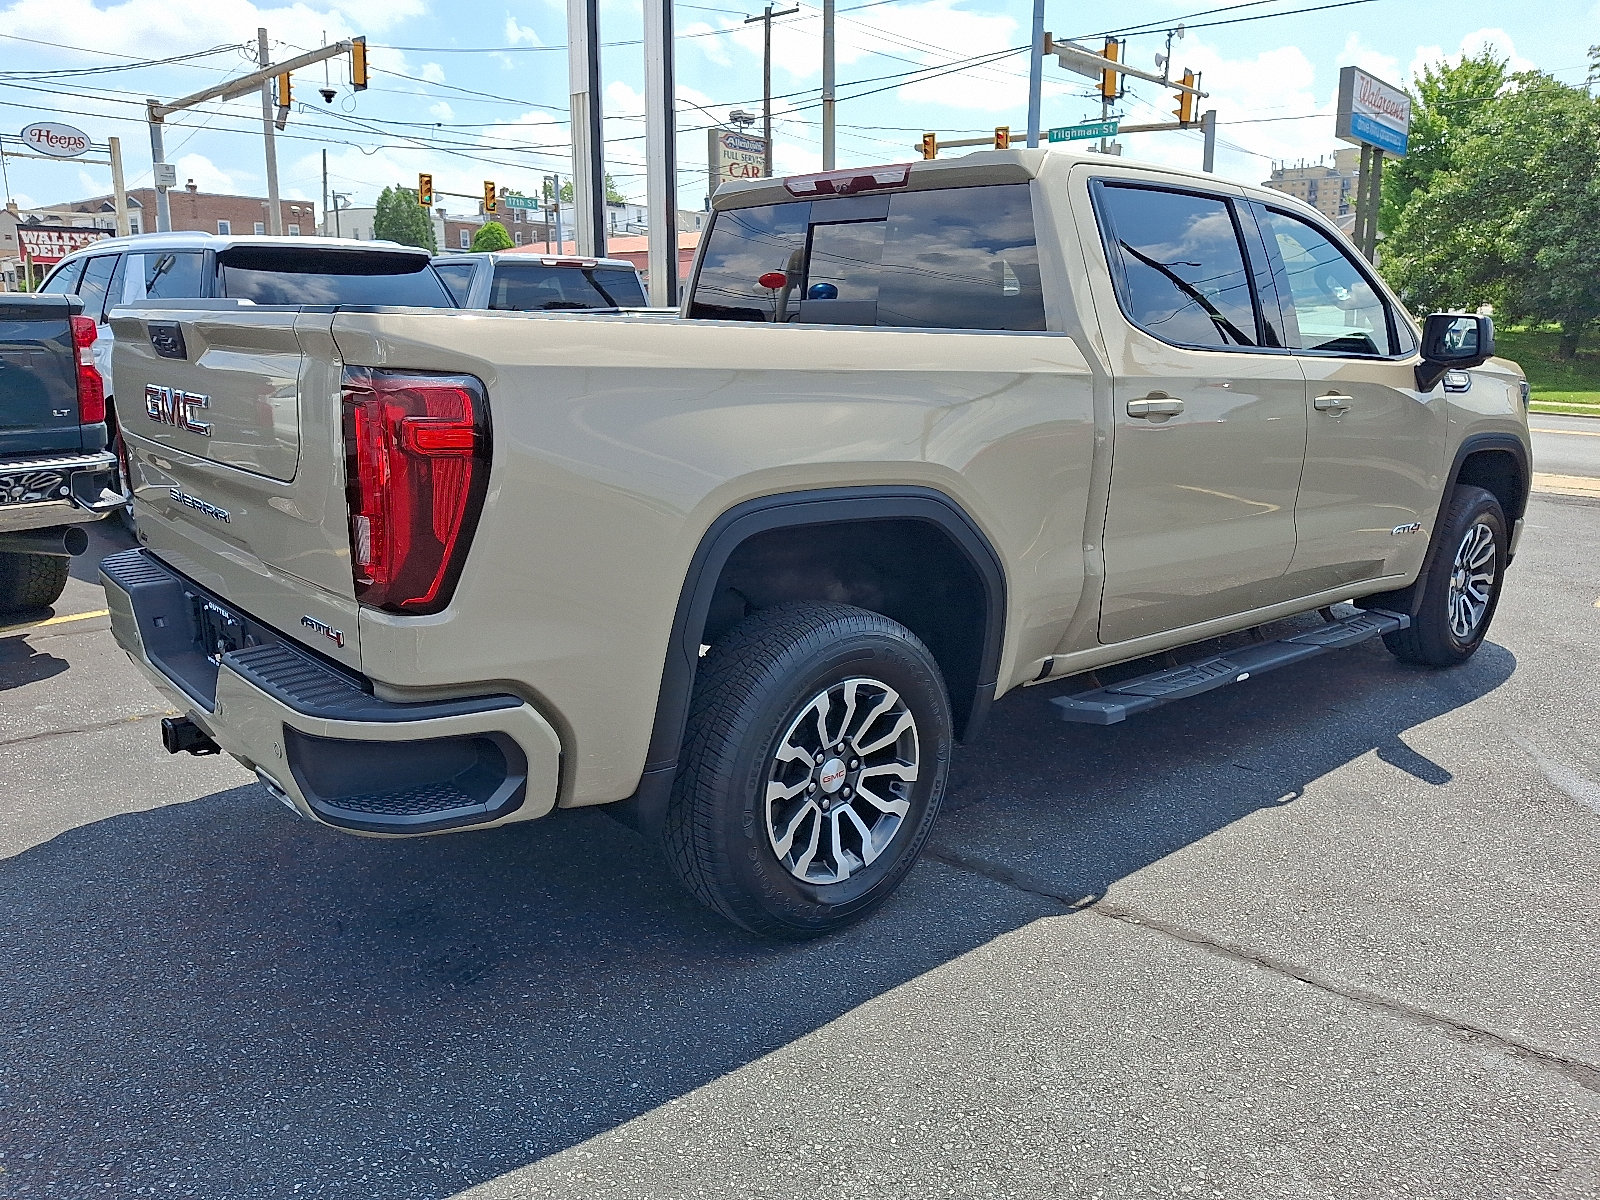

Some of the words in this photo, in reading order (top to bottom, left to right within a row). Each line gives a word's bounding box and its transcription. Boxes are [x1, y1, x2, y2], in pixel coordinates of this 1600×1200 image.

[1359, 75, 1404, 121] Walgreens
[29, 128, 85, 149] Heeps
[1051, 128, 1099, 140] Tilghman
[1102, 124, 1114, 134] St
[723, 150, 739, 161] FULL
[729, 162, 760, 178] CAR
[508, 197, 525, 206] 17th
[527, 199, 536, 208] St
[52, 409, 71, 417] LT
[145, 383, 213, 437] GMC
[169, 488, 231, 524] SIERRA
[822, 769, 844, 783] GMC
